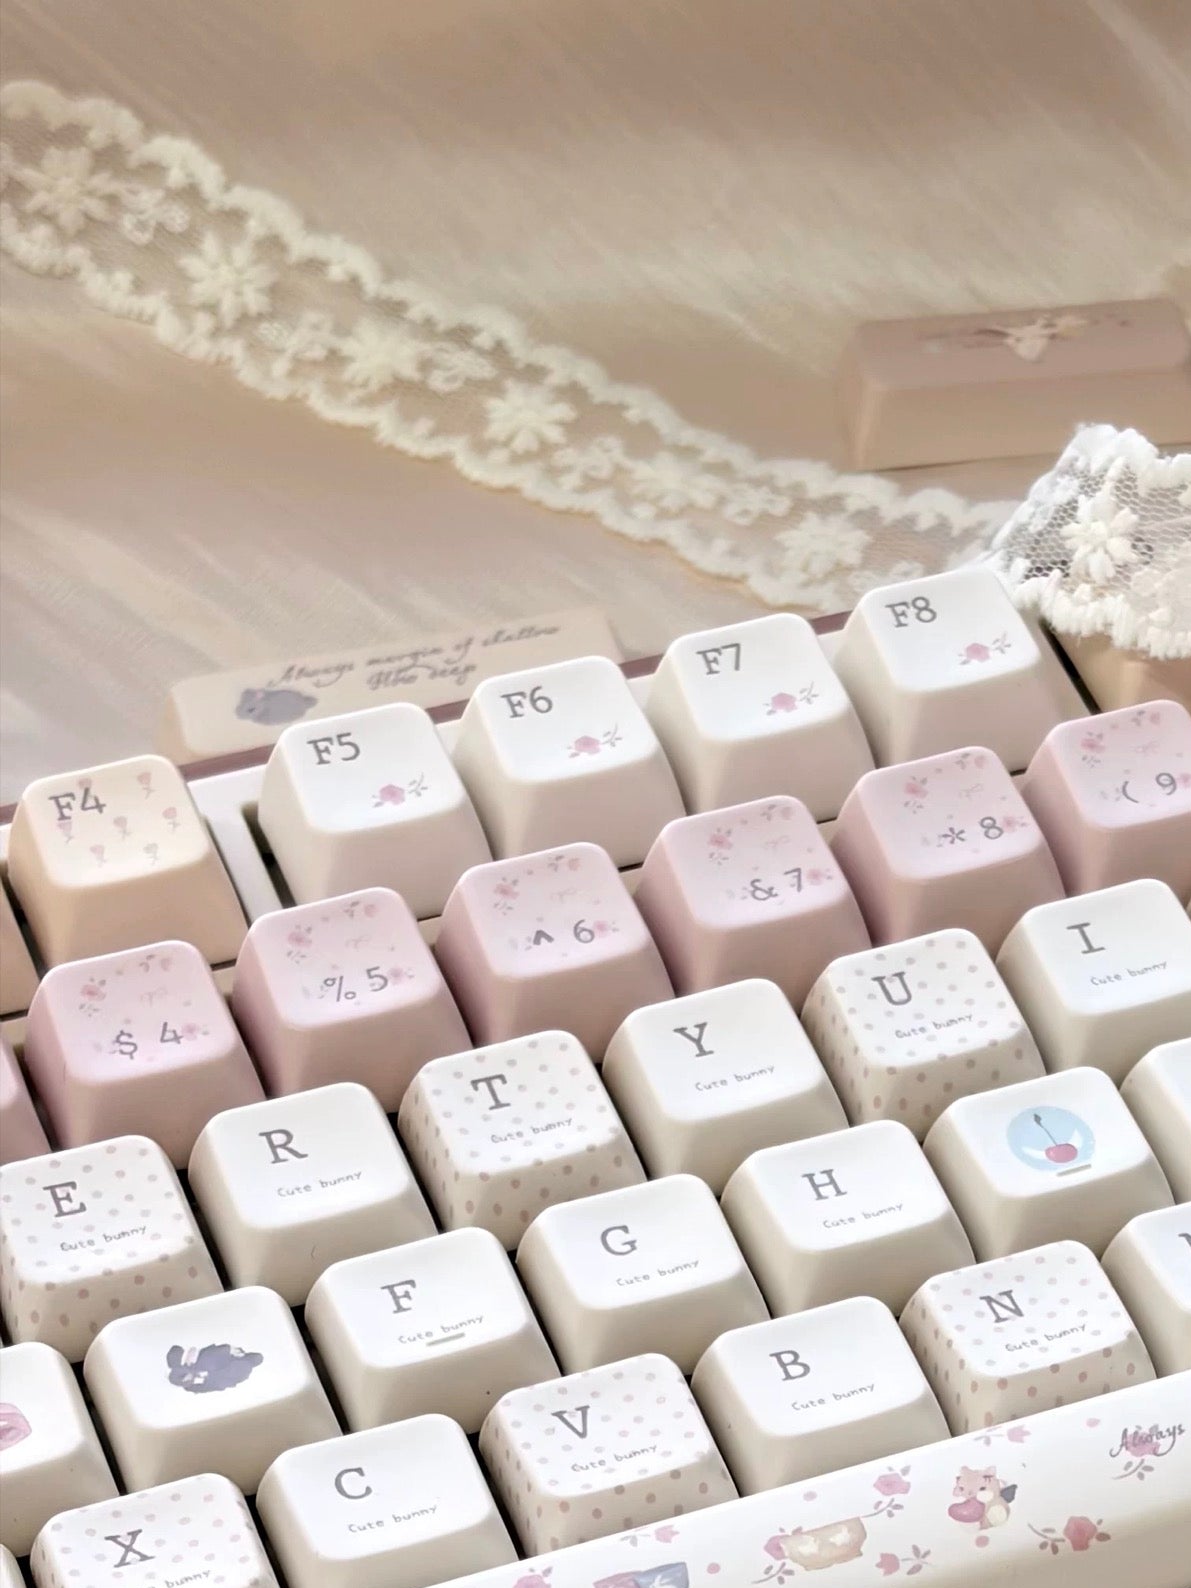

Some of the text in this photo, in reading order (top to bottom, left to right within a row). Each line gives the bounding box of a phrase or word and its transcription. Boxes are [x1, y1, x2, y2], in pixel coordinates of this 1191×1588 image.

[885, 596, 938, 628] F8
[696, 643, 742, 676] F7
[501, 685, 553, 718] F6
[308, 733, 360, 765] F5
[1156, 772, 1177, 796] 9
[49, 786, 106, 822] F4
[979, 816, 1004, 840] 8
[750, 867, 802, 902] & 7
[574, 919, 595, 944] 6
[1066, 922, 1105, 954] I
[324, 967, 388, 1002] % 5
[872, 971, 913, 1007] U
[1090, 961, 1168, 986] Cute bunny
[116, 1021, 183, 1060] $ 4
[673, 1022, 715, 1058] Y
[895, 1013, 973, 1039] Cute bunny
[470, 1074, 510, 1110] T
[695, 1065, 775, 1092] Cute bunny
[259, 1128, 308, 1164] R
[490, 1117, 573, 1144] Cute bunny
[43, 1181, 87, 1218] E
[277, 1171, 362, 1198] Cute bunny
[802, 1168, 847, 1201] H
[823, 1203, 904, 1229] Cute bunny
[60, 1224, 147, 1252] Cute bunny
[600, 1224, 638, 1257] G
[616, 1259, 699, 1287] Cute bunny
[380, 1280, 416, 1313] F
[980, 1289, 1026, 1323] N
[398, 1315, 483, 1345] Cute bunny
[1005, 1323, 1086, 1352] Cute bunny
[769, 1349, 811, 1381] B
[791, 1383, 875, 1412] Cute bunny
[551, 1406, 591, 1440] V
[1109, 1424, 1185, 1457] Always
[571, 1444, 658, 1473] Cute bunny
[334, 1468, 373, 1500] C
[347, 1504, 437, 1534] Cute bunny
[104, 1529, 155, 1567] X
